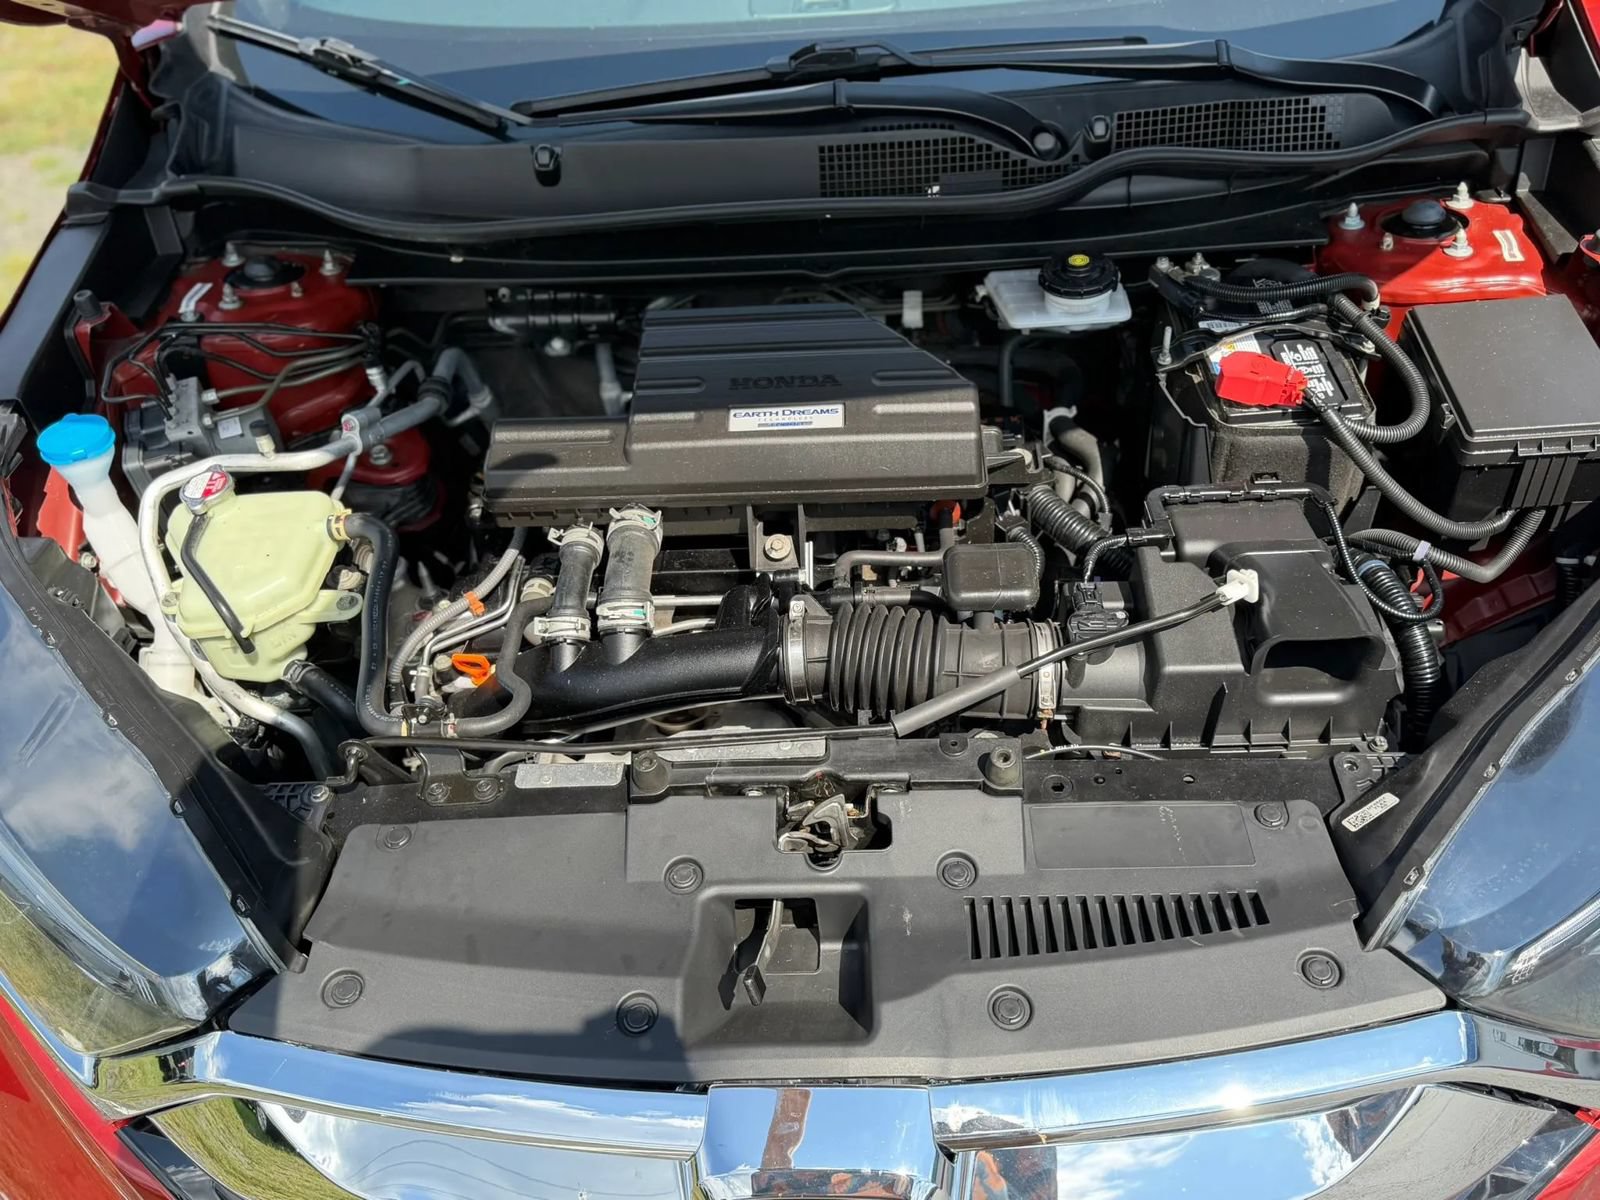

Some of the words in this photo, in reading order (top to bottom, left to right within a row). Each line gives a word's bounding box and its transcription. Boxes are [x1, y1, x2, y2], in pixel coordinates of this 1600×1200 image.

[728, 374, 842, 390] HONDA
[733, 410, 779, 418] EARTH
[782, 408, 839, 416] DREAMS
